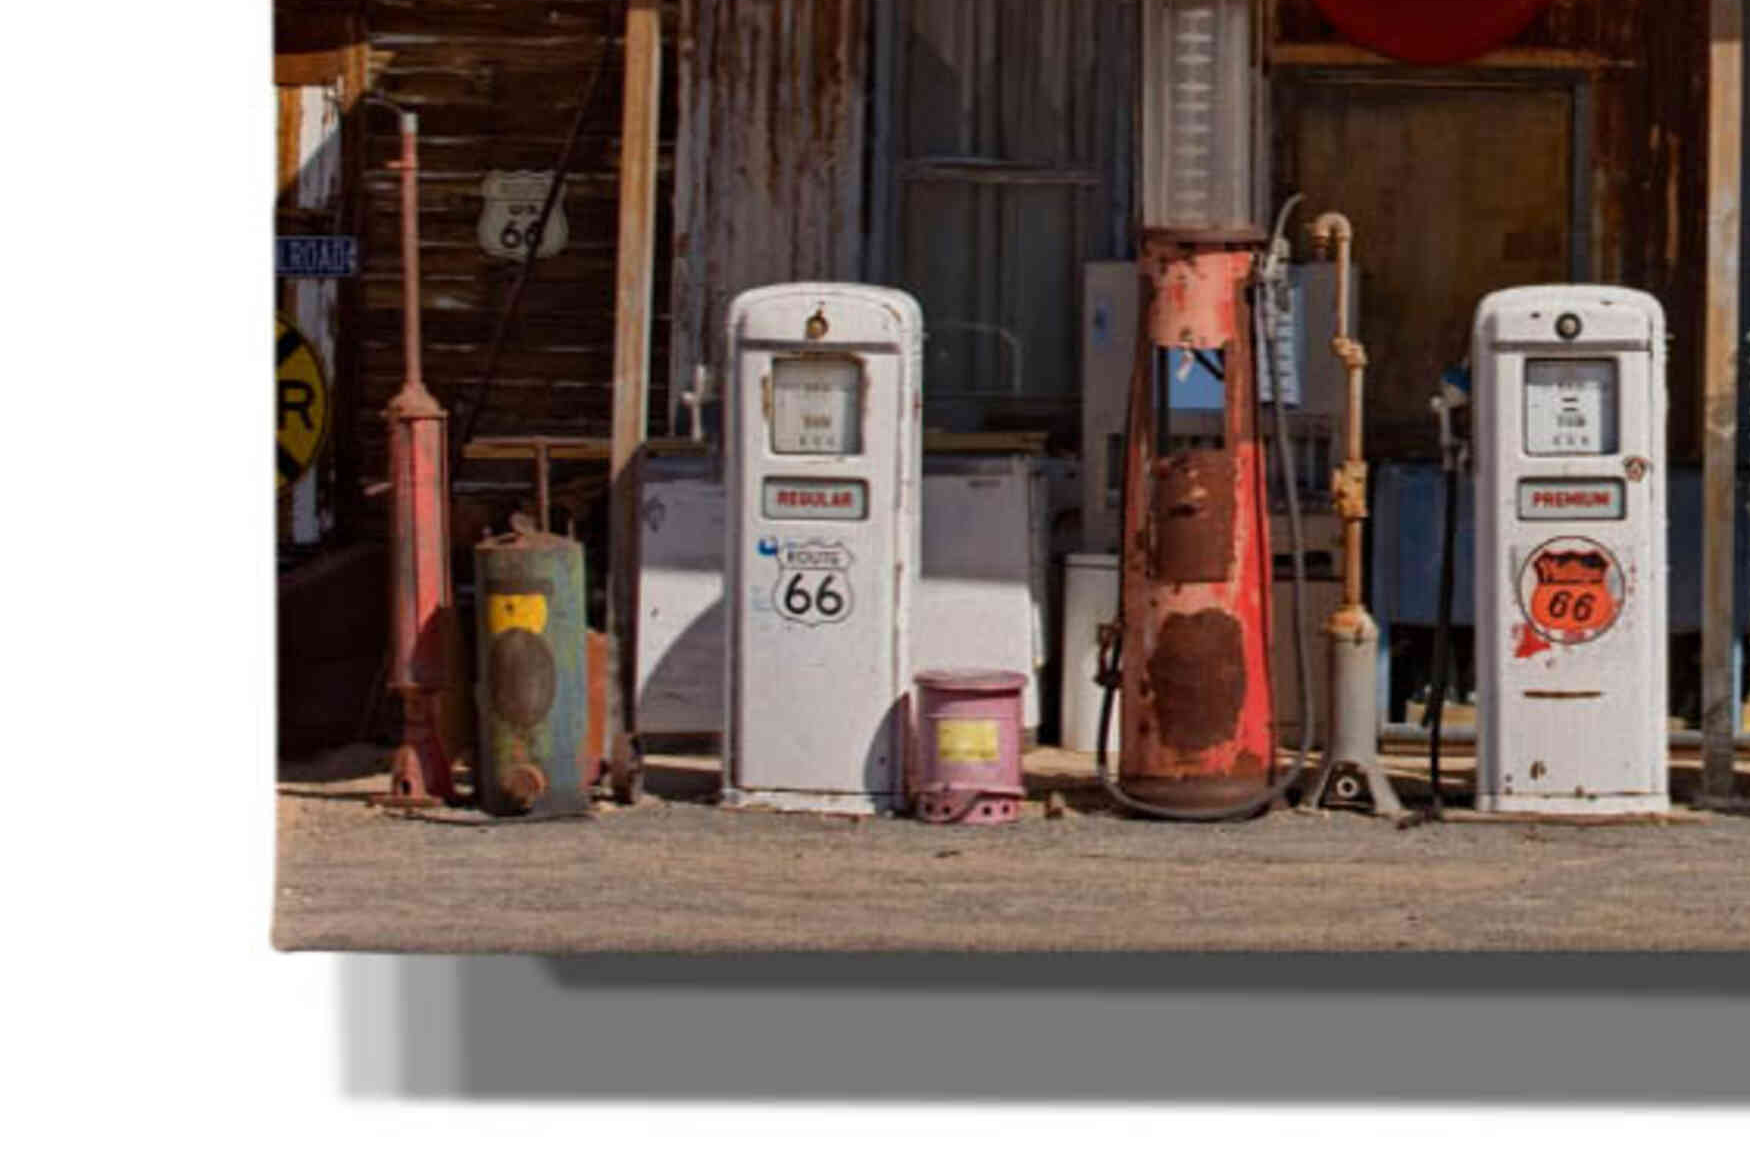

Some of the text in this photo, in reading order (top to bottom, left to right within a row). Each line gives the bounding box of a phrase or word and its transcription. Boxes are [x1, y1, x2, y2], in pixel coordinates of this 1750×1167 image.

[278, 380, 315, 430] R
[776, 491, 854, 508] REGULAR
[1532, 491, 1611, 508] PREMIUM
[784, 571, 844, 616] 66
[1548, 590, 1598, 623] 66
